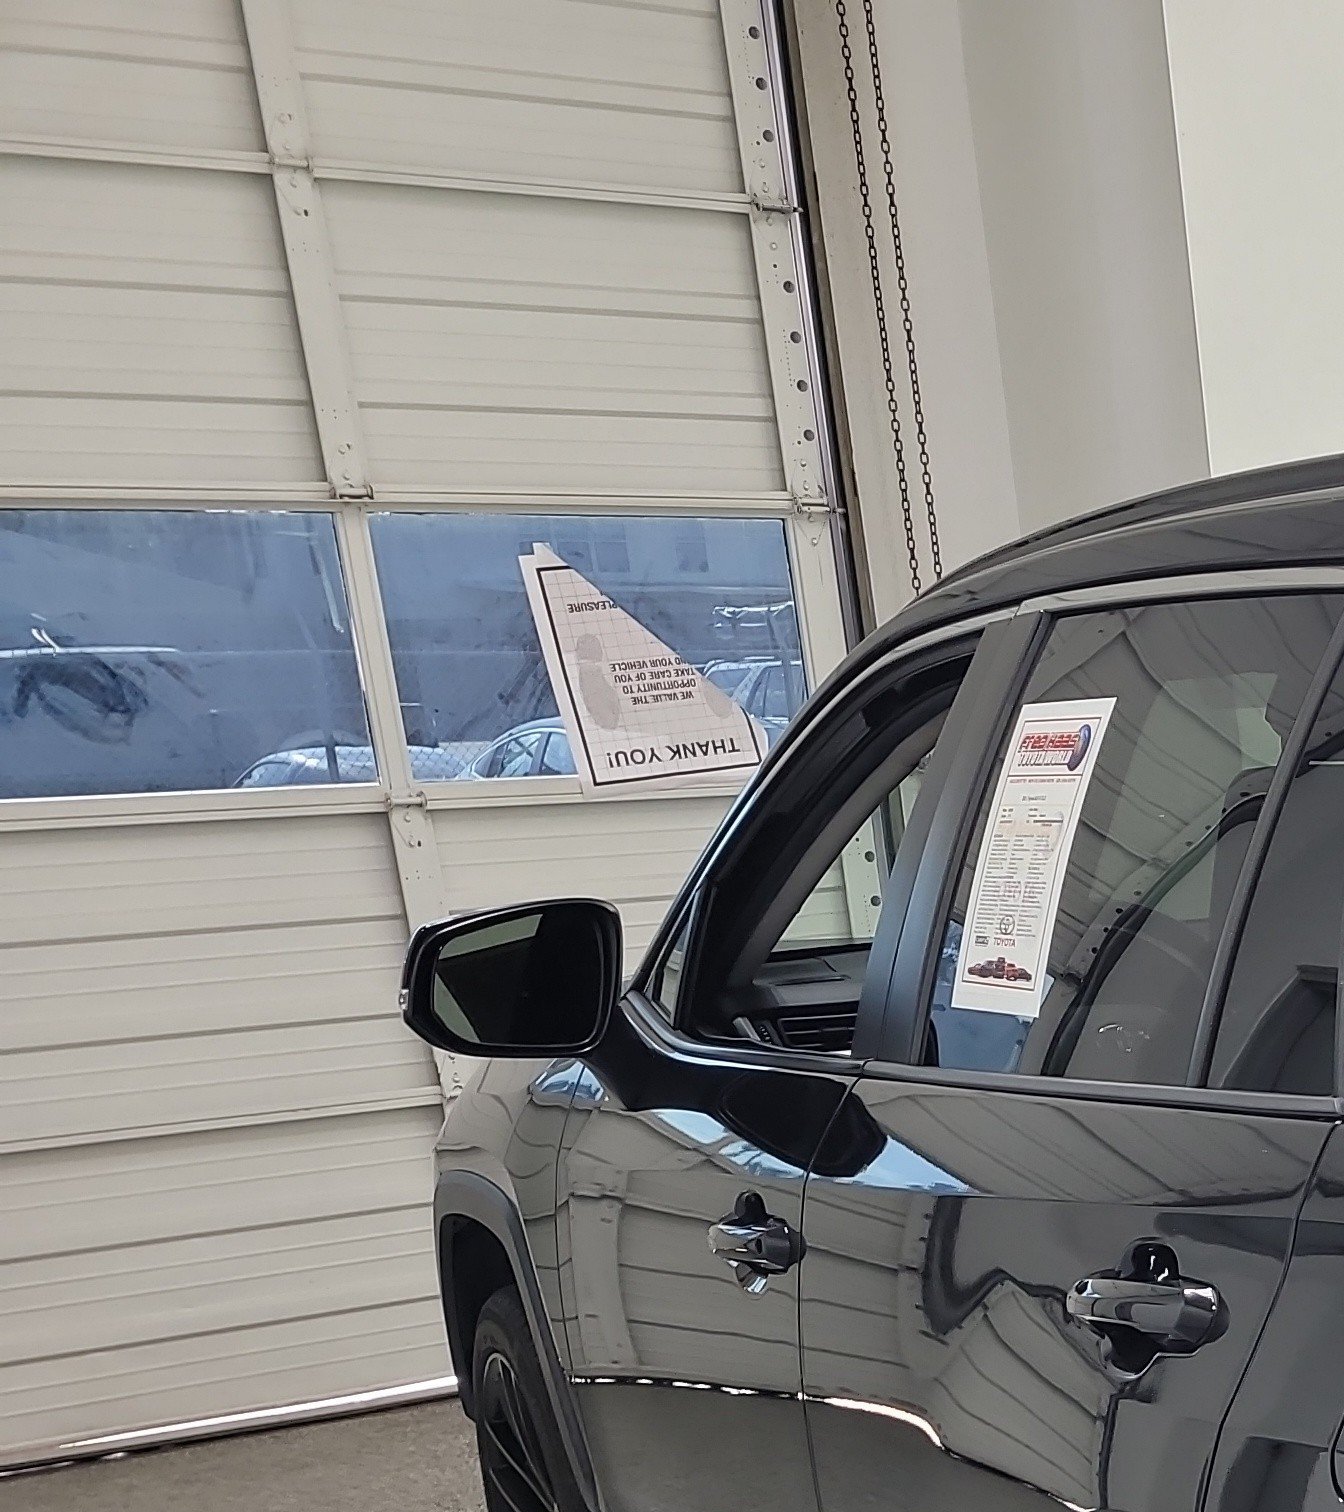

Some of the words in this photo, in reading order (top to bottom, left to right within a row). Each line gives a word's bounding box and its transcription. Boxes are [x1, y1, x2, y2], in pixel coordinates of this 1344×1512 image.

[609, 660, 649, 673] VEHICLE
[649, 657, 673, 668] YOUR
[635, 671, 647, 682] OF
[649, 669, 672, 680] CARE
[673, 667, 696, 678] TAKE
[613, 673, 634, 684] YOU
[622, 685, 636, 695] TO
[637, 678, 697, 694] OPPORTUNITY
[630, 694, 650, 706] THE
[651, 691, 680, 704] VALUE
[680, 690, 695, 701] WE
[665, 737, 741, 761] THANK
[606, 747, 663, 769] YOU!
